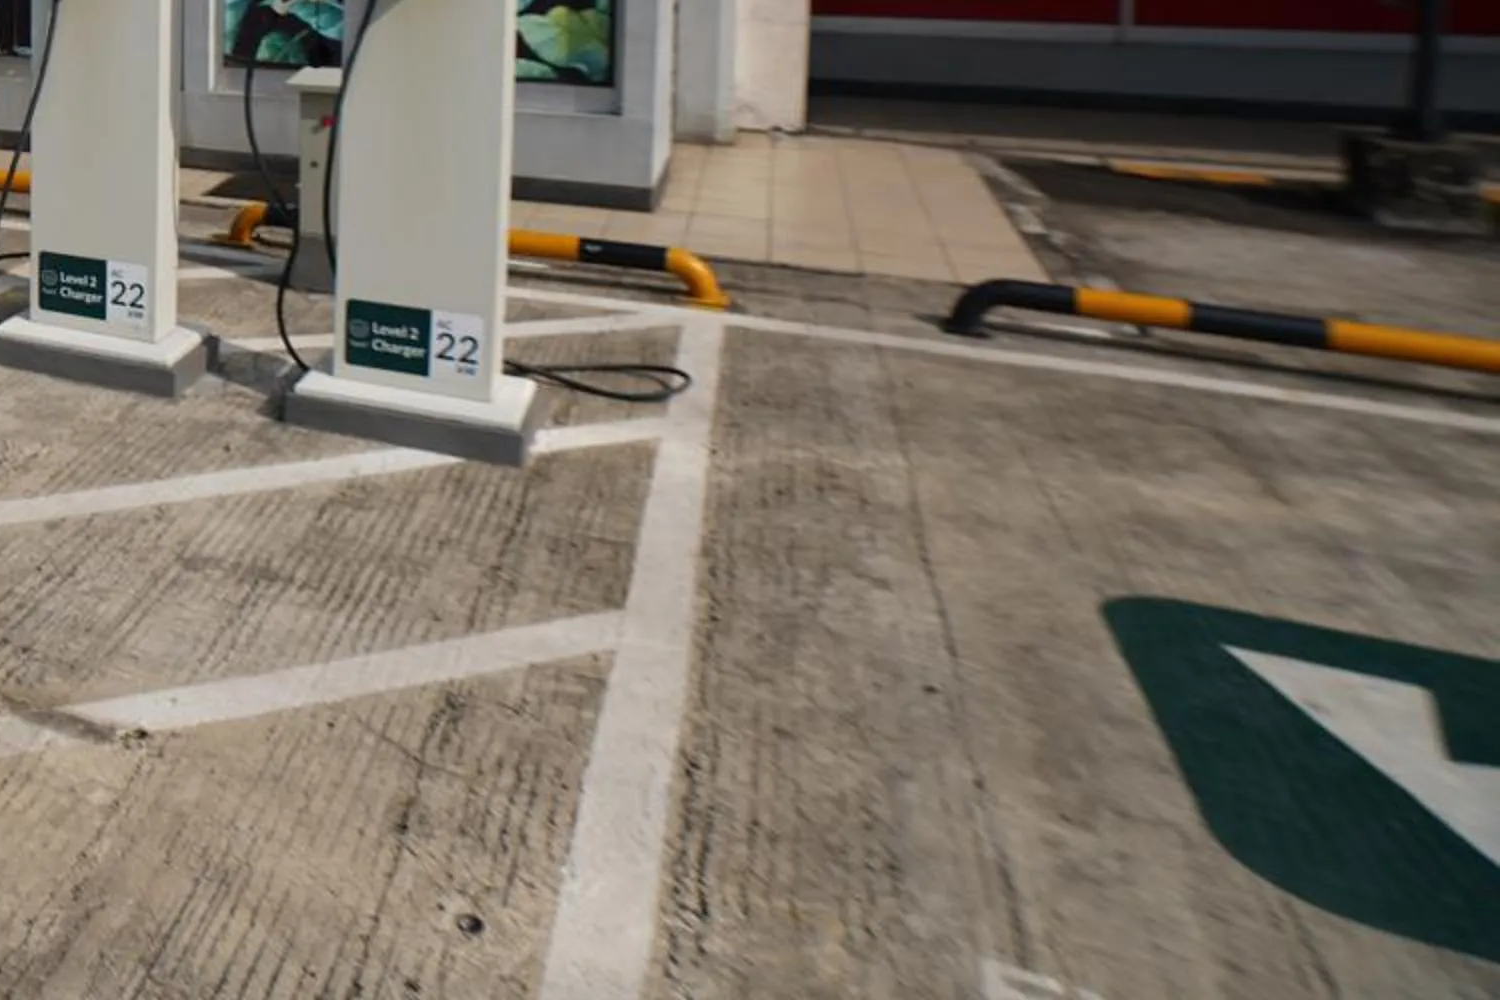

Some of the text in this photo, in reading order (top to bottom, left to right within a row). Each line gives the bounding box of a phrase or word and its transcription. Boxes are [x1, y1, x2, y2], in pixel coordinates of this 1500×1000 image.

[60, 271, 97, 288] Level 2
[60, 286, 103, 304] Charger
[111, 280, 145, 309] 22
[371, 321, 420, 341] Level 2
[371, 338, 426, 359] Charger
[435, 333, 479, 365] 22
